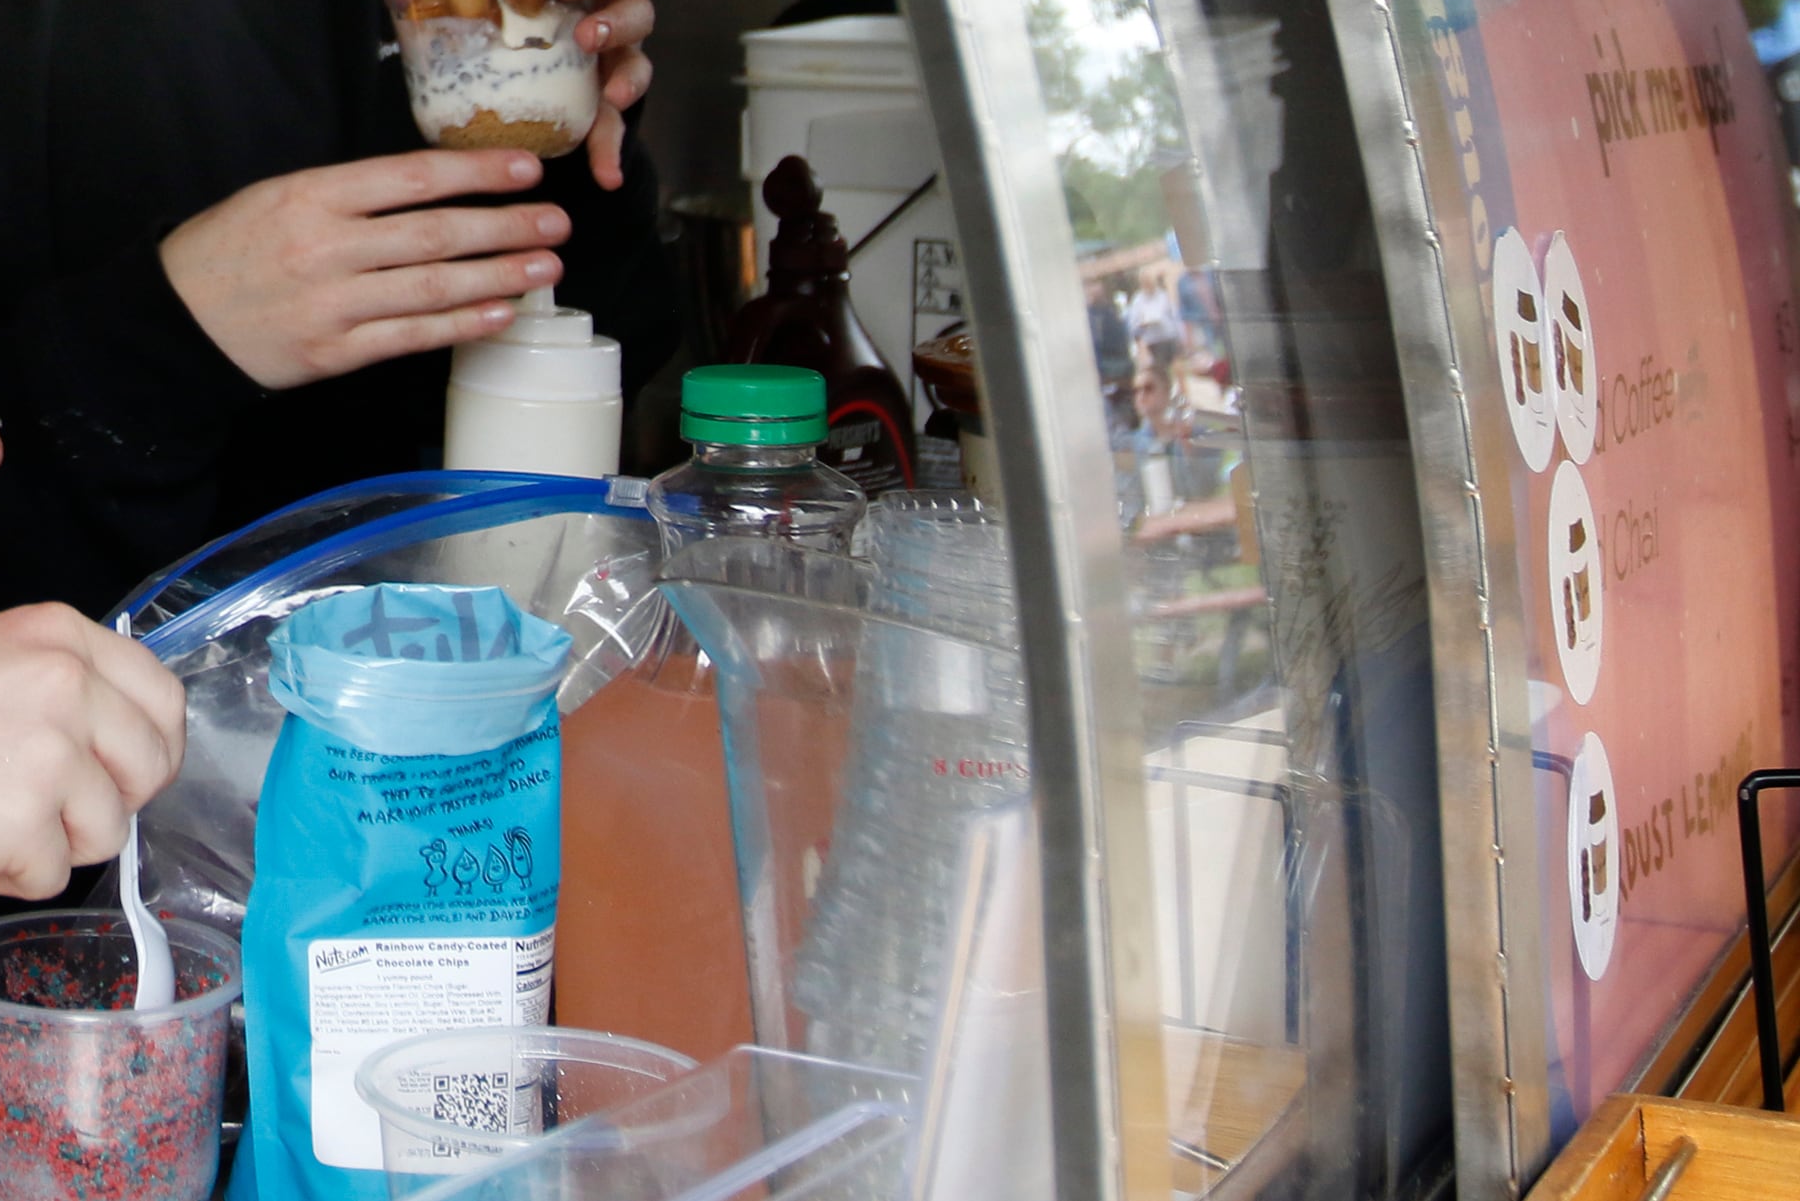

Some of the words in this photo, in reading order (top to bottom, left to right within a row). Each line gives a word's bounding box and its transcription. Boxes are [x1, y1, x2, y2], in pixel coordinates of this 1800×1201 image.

[1585, 26, 1648, 178] pick
[1644, 65, 1689, 135] me
[1611, 354, 1675, 445] Coffee
[1612, 492, 1660, 581] Chai
[957, 758, 1029, 779] CUPS
[376, 942, 425, 952] Rainbow
[428, 940, 508, 953] Candy-Coated
[376, 958, 434, 968] Chocolate
[437, 957, 470, 969] Chips
